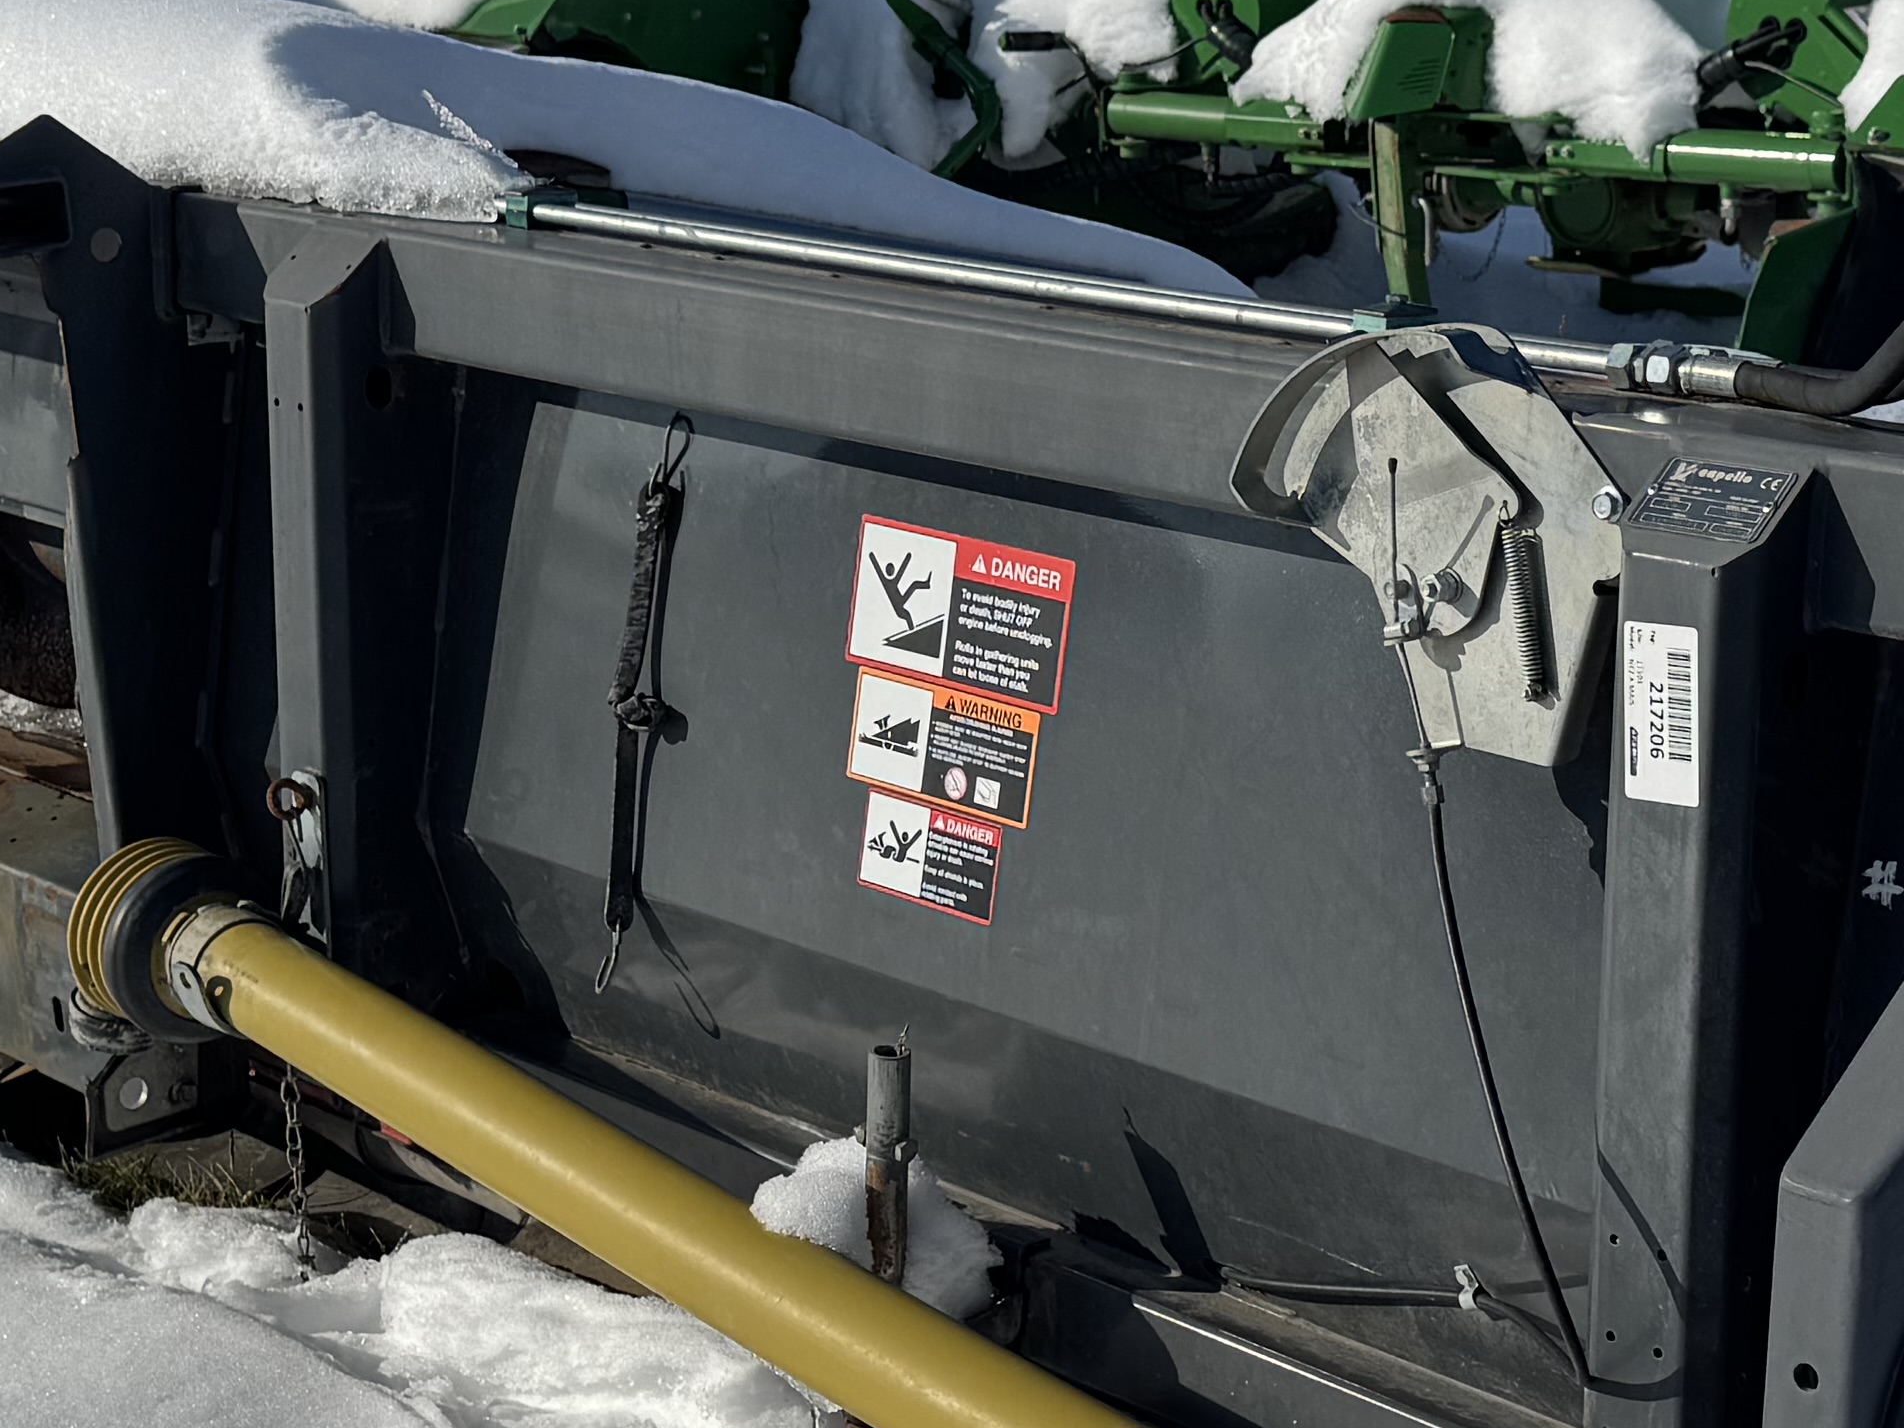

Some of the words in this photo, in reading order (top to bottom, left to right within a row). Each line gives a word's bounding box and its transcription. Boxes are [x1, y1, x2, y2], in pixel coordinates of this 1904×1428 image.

[991, 557, 1062, 591] DANGER
[959, 698, 1022, 729] WARNING
[1650, 682, 1664, 759] 217206
[946, 818, 994, 846] DANGER
